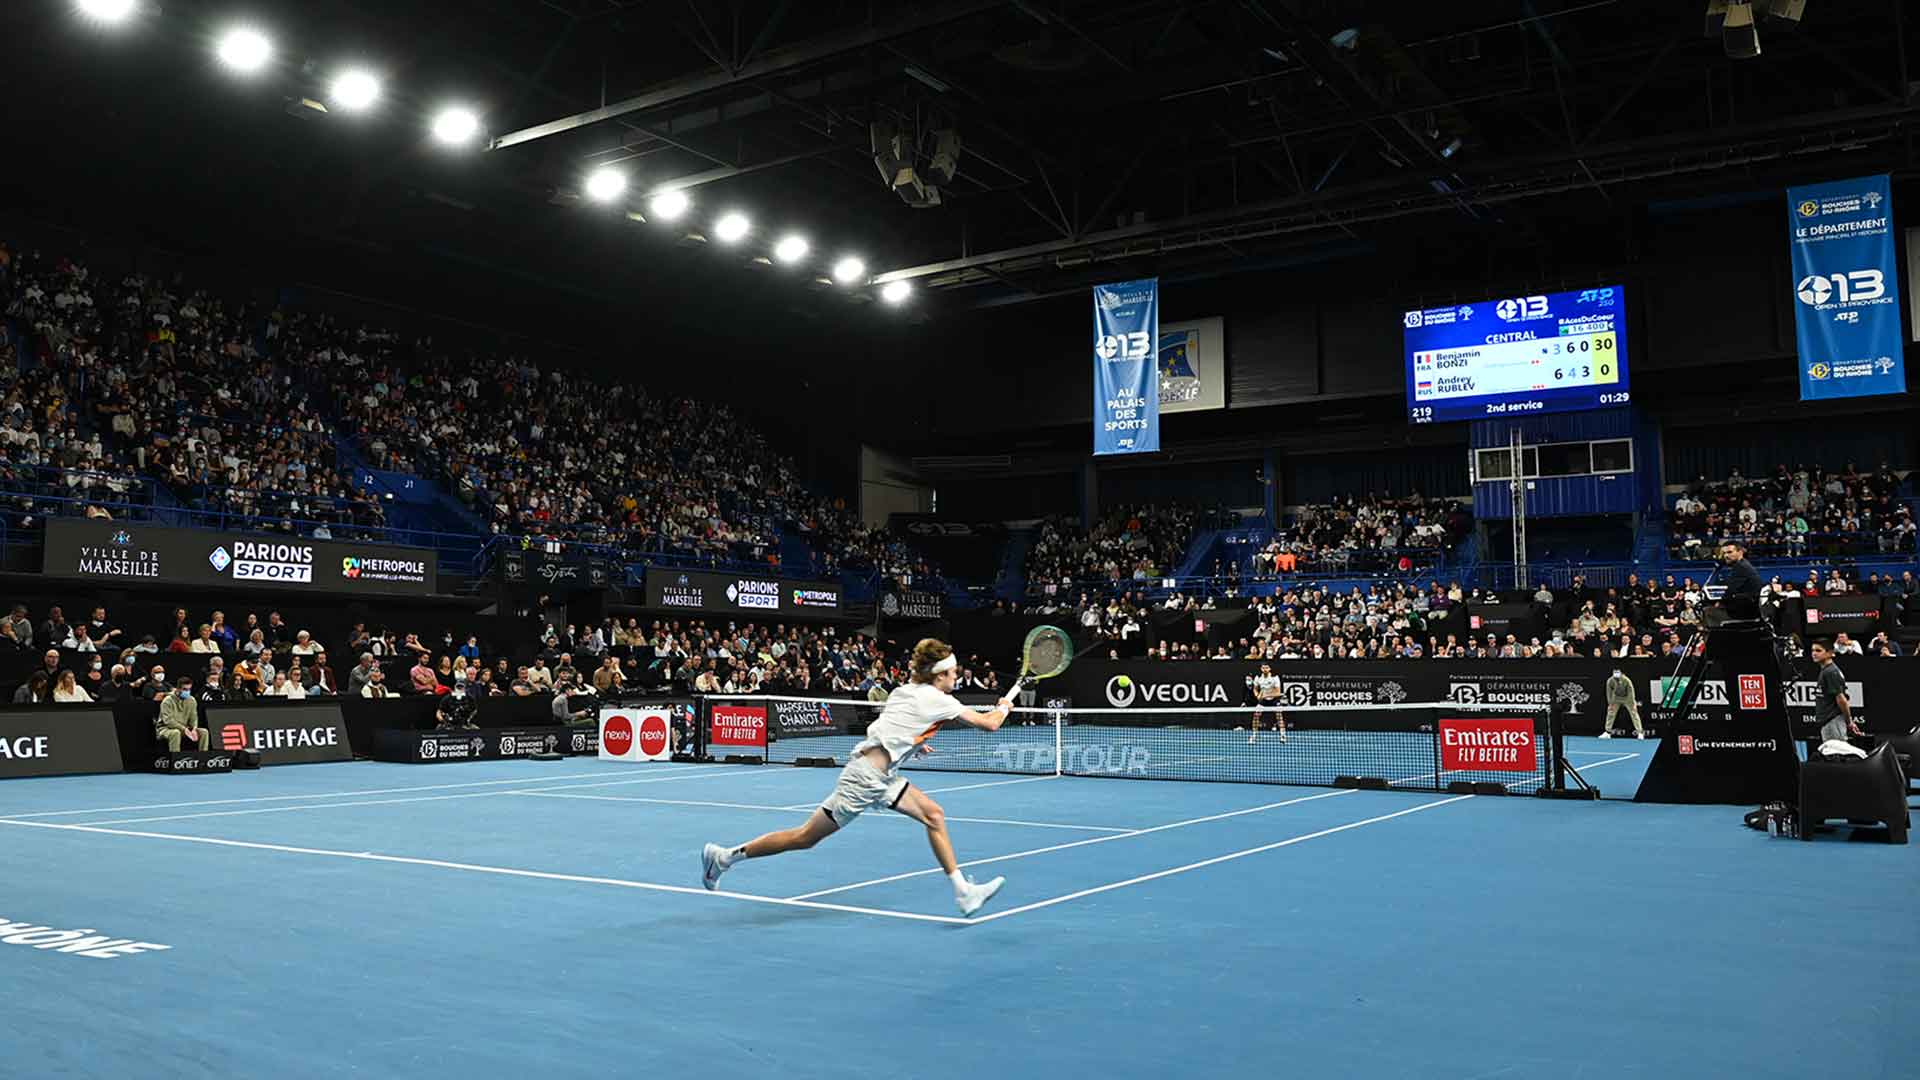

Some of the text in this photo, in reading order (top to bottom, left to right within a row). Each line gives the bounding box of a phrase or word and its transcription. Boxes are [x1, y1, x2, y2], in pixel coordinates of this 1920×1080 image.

[1796, 217, 1887, 238] LE DÉPARTEMENT
[1485, 330, 1537, 344] CENTRAL
[1436, 338, 1613, 361] Benjamin 3 6 0 30
[1436, 358, 1468, 369] BONZI
[1437, 364, 1610, 386] Andrey 6 4 3 0
[1117, 388, 1134, 398] AU
[1437, 382, 1475, 393] RUBLEV
[1107, 397, 1145, 410] PALAIS
[1486, 392, 1630, 414] 2nd service 01:29
[1115, 409, 1137, 420] DES
[1412, 406, 1432, 418] 219
[1104, 418, 1148, 432] SPORTS
[81, 547, 158, 562] VILLE DE
[233, 541, 313, 564] PARIONS
[79, 559, 160, 577] MARSEILLE
[236, 563, 309, 579] SPORT
[663, 587, 702, 596] VILLE DE
[738, 580, 779, 595] PARIONS
[662, 595, 703, 607] MARSEILLE
[740, 595, 777, 606] SPORT
[901, 593, 926, 604] VILLE
[901, 604, 942, 618] MARSEILLE
[1743, 679, 1761, 689] TEN
[1140, 684, 1228, 702] VEOLIA
[1316, 691, 1373, 701] BOUCHES
[1488, 693, 1551, 703] BOUCHES
[1744, 694, 1762, 704] NIS
[775, 701, 819, 713] MARSEILLE
[714, 712, 764, 728] Emirates
[779, 713, 819, 726] CHANOT
[253, 727, 337, 749] EIFFAGE
[605, 730, 631, 741] nexity
[641, 730, 665, 741] nexity
[721, 728, 757, 740] FLY BETTER
[1444, 728, 1529, 747] Emirates
[0, 736, 48, 758] AGE
[439, 744, 469, 752] BOUCHES
[1062, 744, 1150, 775] TOUR
[1458, 748, 1518, 762] FLY BETTER
